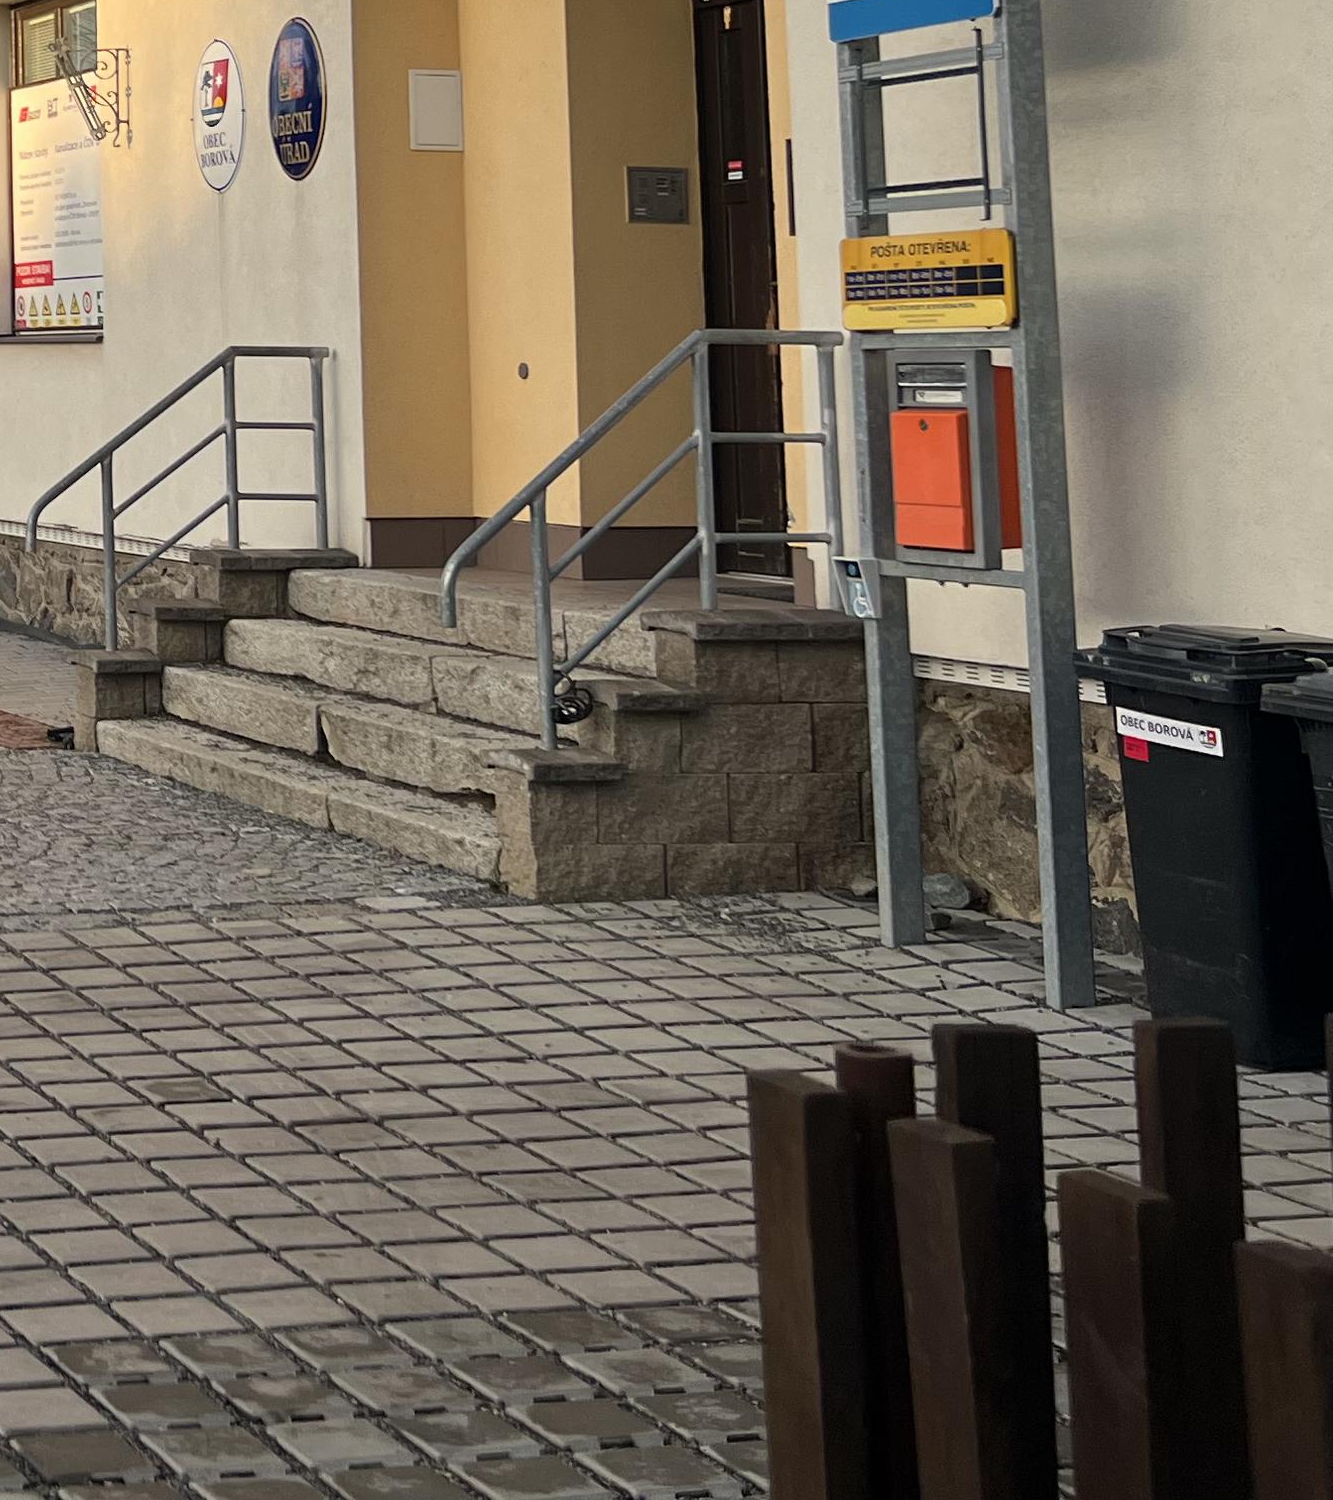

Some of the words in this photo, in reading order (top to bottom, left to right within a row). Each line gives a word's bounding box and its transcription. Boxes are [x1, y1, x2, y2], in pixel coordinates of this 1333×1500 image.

[273, 103, 313, 138] OBECNÍ
[203, 132, 227, 149] OBEC
[280, 137, 310, 165] ÚŘAD
[200, 144, 236, 168] BOROVÁ
[870, 242, 904, 258] POŠTA
[1121, 715, 1145, 731] OBEC
[1148, 722, 1194, 741] BOROVÁ
